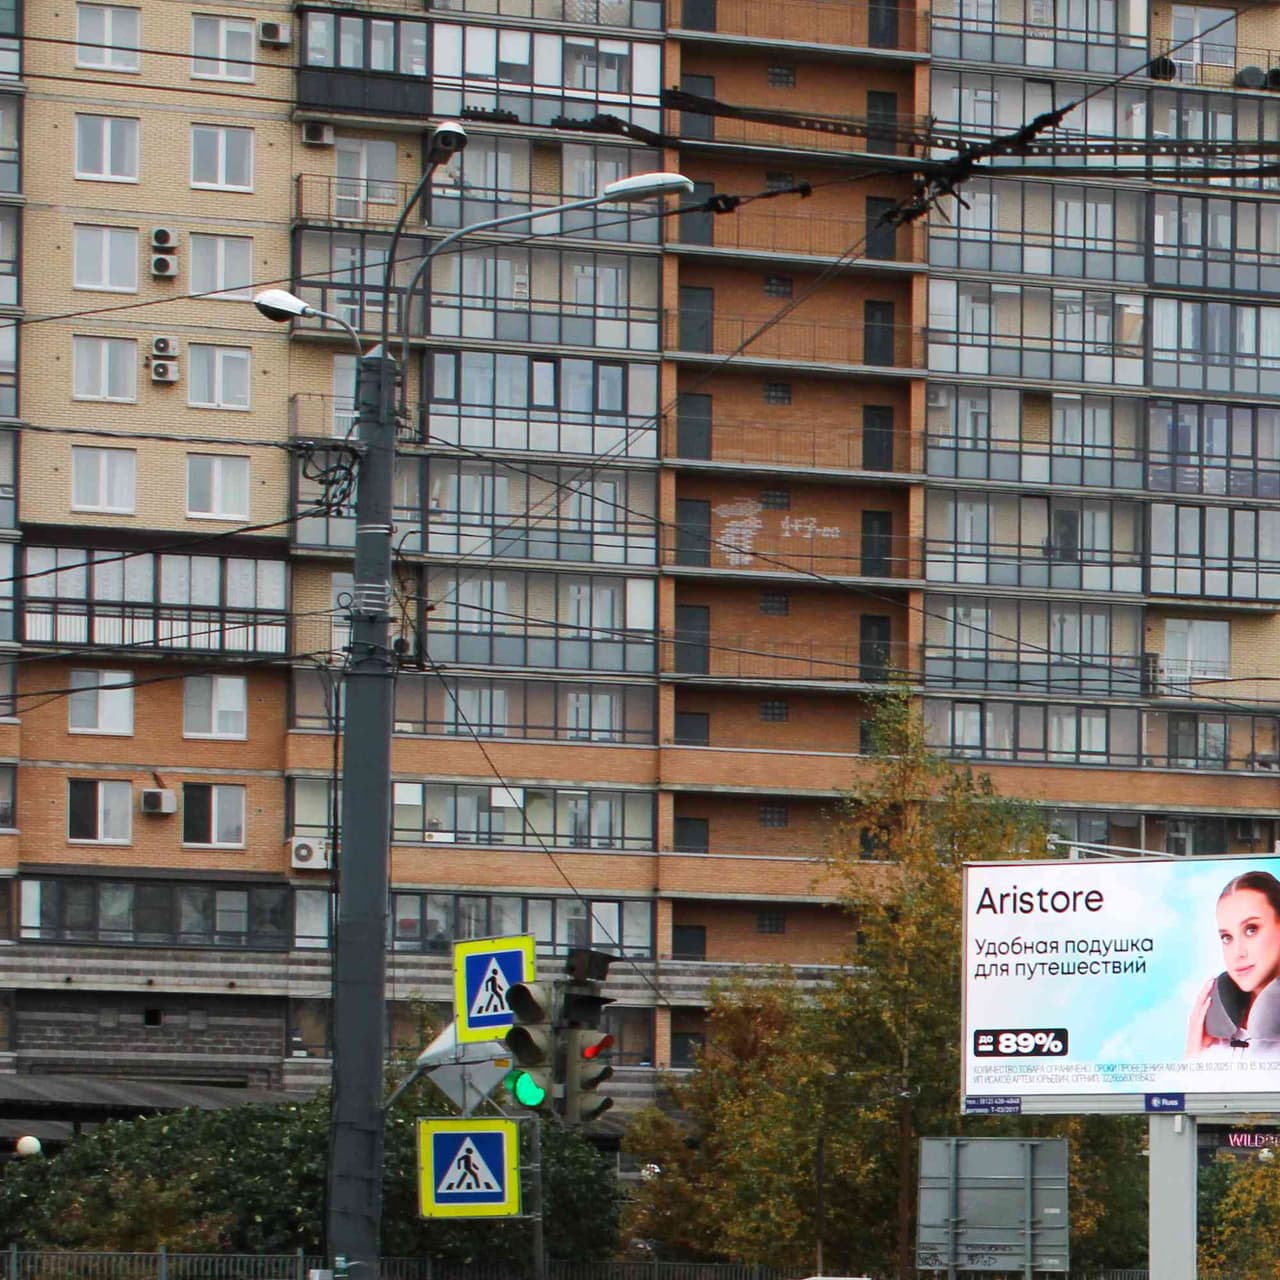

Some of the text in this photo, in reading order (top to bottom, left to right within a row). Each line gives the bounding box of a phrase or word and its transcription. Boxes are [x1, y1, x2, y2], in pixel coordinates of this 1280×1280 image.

[975, 885, 1105, 914] Aristore
[975, 936, 1154, 957] Удобная подушка
[974, 956, 1147, 980] для путешествий
[979, 1035, 994, 1044] до
